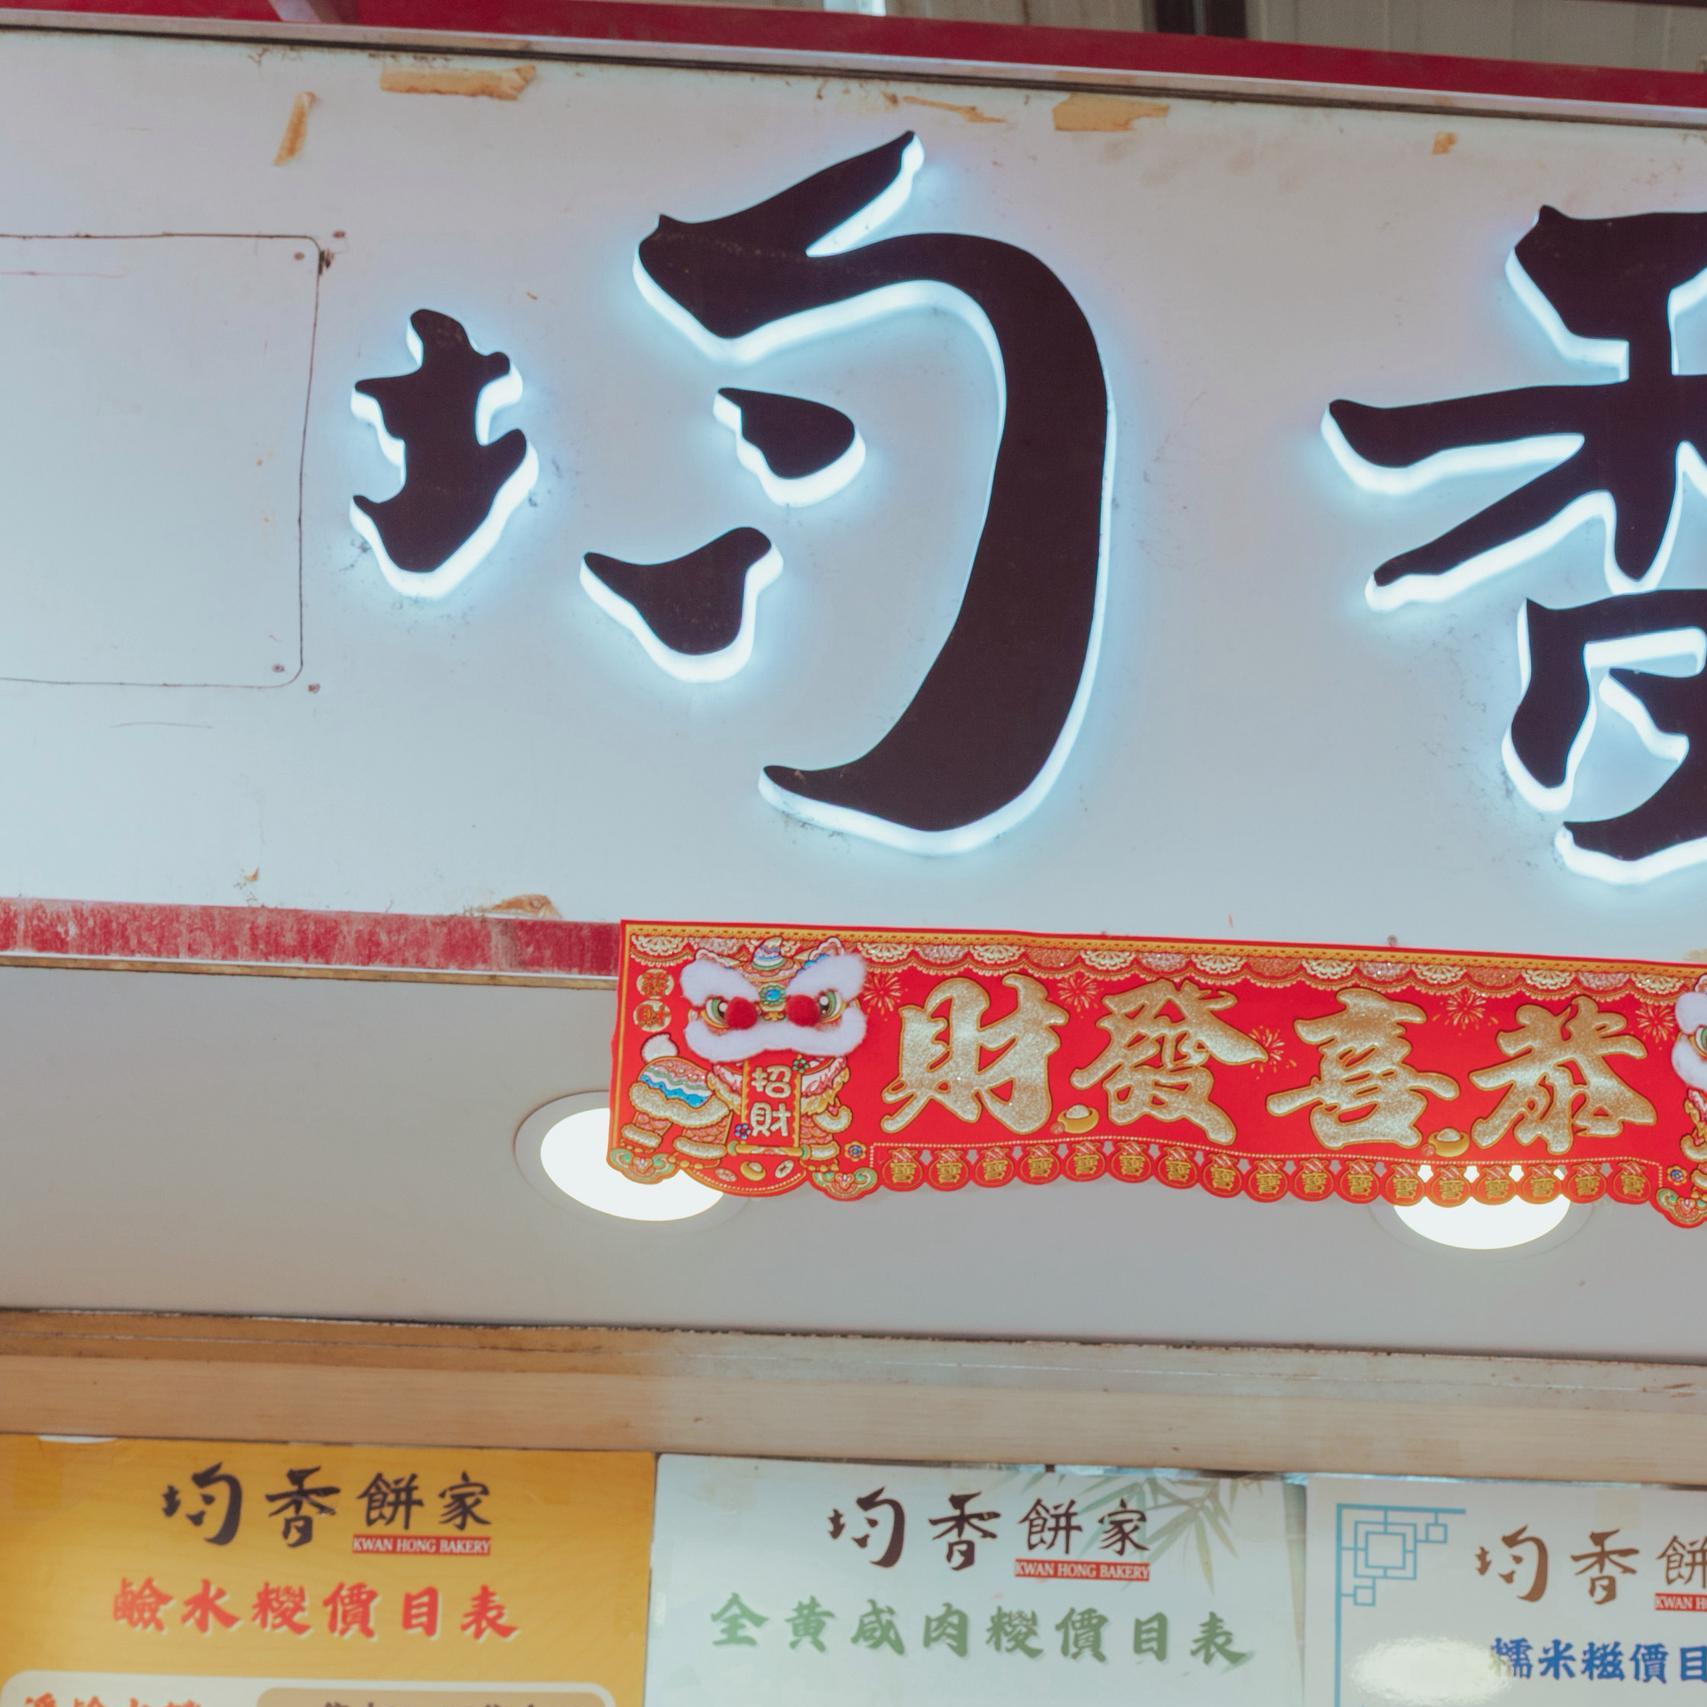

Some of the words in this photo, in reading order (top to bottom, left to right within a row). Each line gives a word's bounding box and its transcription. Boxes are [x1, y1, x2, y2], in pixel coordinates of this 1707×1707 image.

[163, 1462, 491, 1549] 均香餅家
[827, 1486, 1150, 1569] 均香餅家
[354, 1537, 393, 1553] KWAN
[397, 1538, 435, 1554] HONG
[439, 1539, 490, 1556] BAKERY
[1015, 1561, 1053, 1577] KWAN
[1057, 1562, 1095, 1579] HONG
[1098, 1563, 1149, 1581] BAKERY
[1656, 1595, 1692, 1609] KWAN
